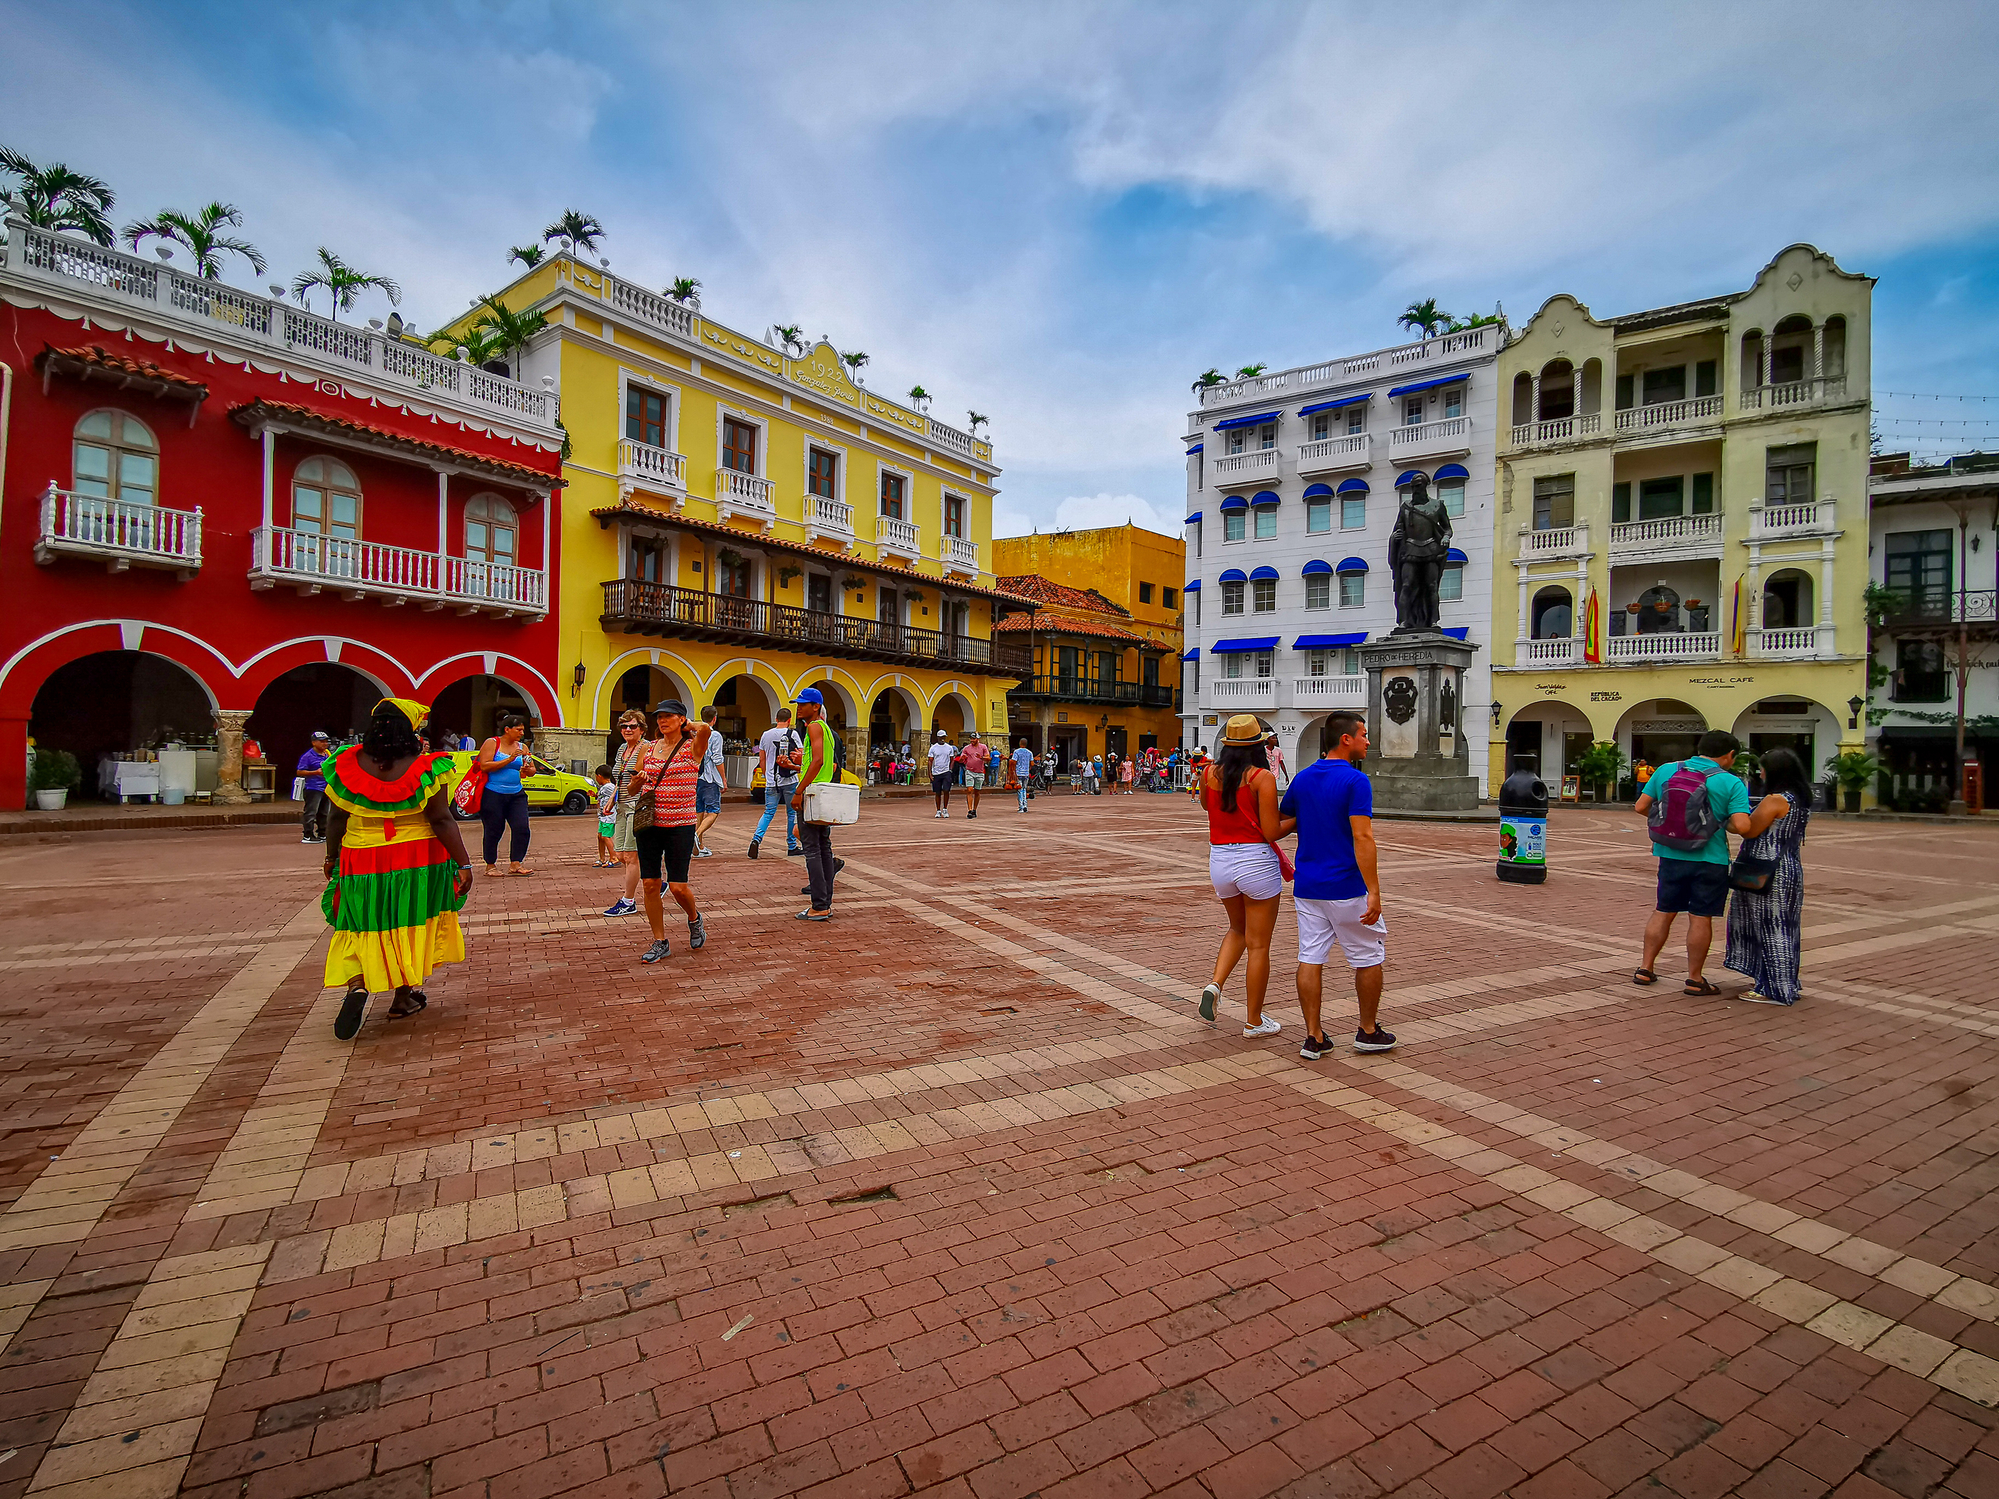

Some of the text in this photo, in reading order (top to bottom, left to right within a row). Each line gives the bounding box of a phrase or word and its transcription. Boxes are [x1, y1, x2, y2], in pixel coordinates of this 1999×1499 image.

[811, 360, 844, 385] 1922
[1364, 653, 1390, 663] PEDRO
[1398, 651, 1433, 661] HEREDIA
